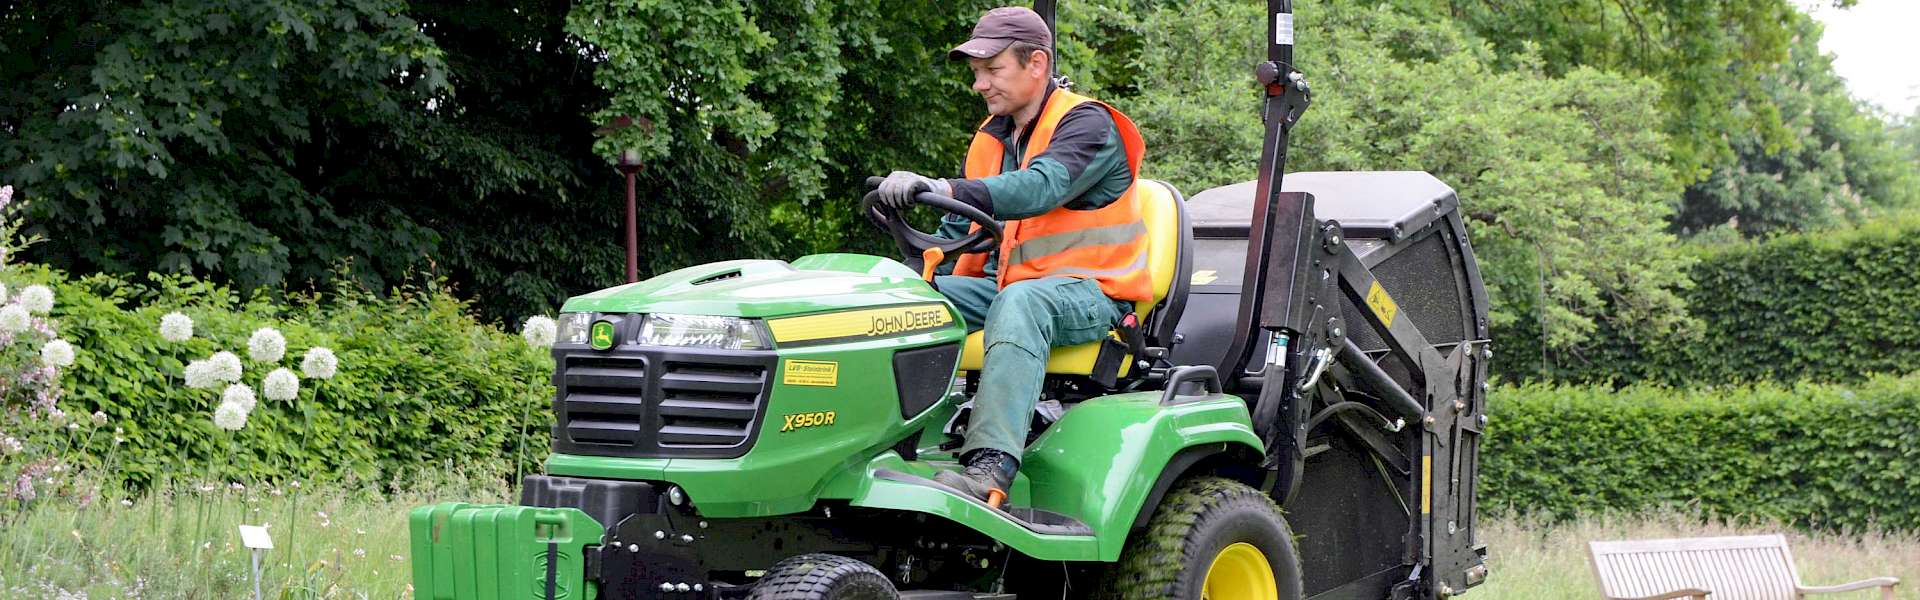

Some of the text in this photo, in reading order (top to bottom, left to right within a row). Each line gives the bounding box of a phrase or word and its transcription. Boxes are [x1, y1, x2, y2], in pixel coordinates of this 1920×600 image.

[868, 310, 942, 334] JOHN DEERE
[781, 411, 836, 431] X950R
